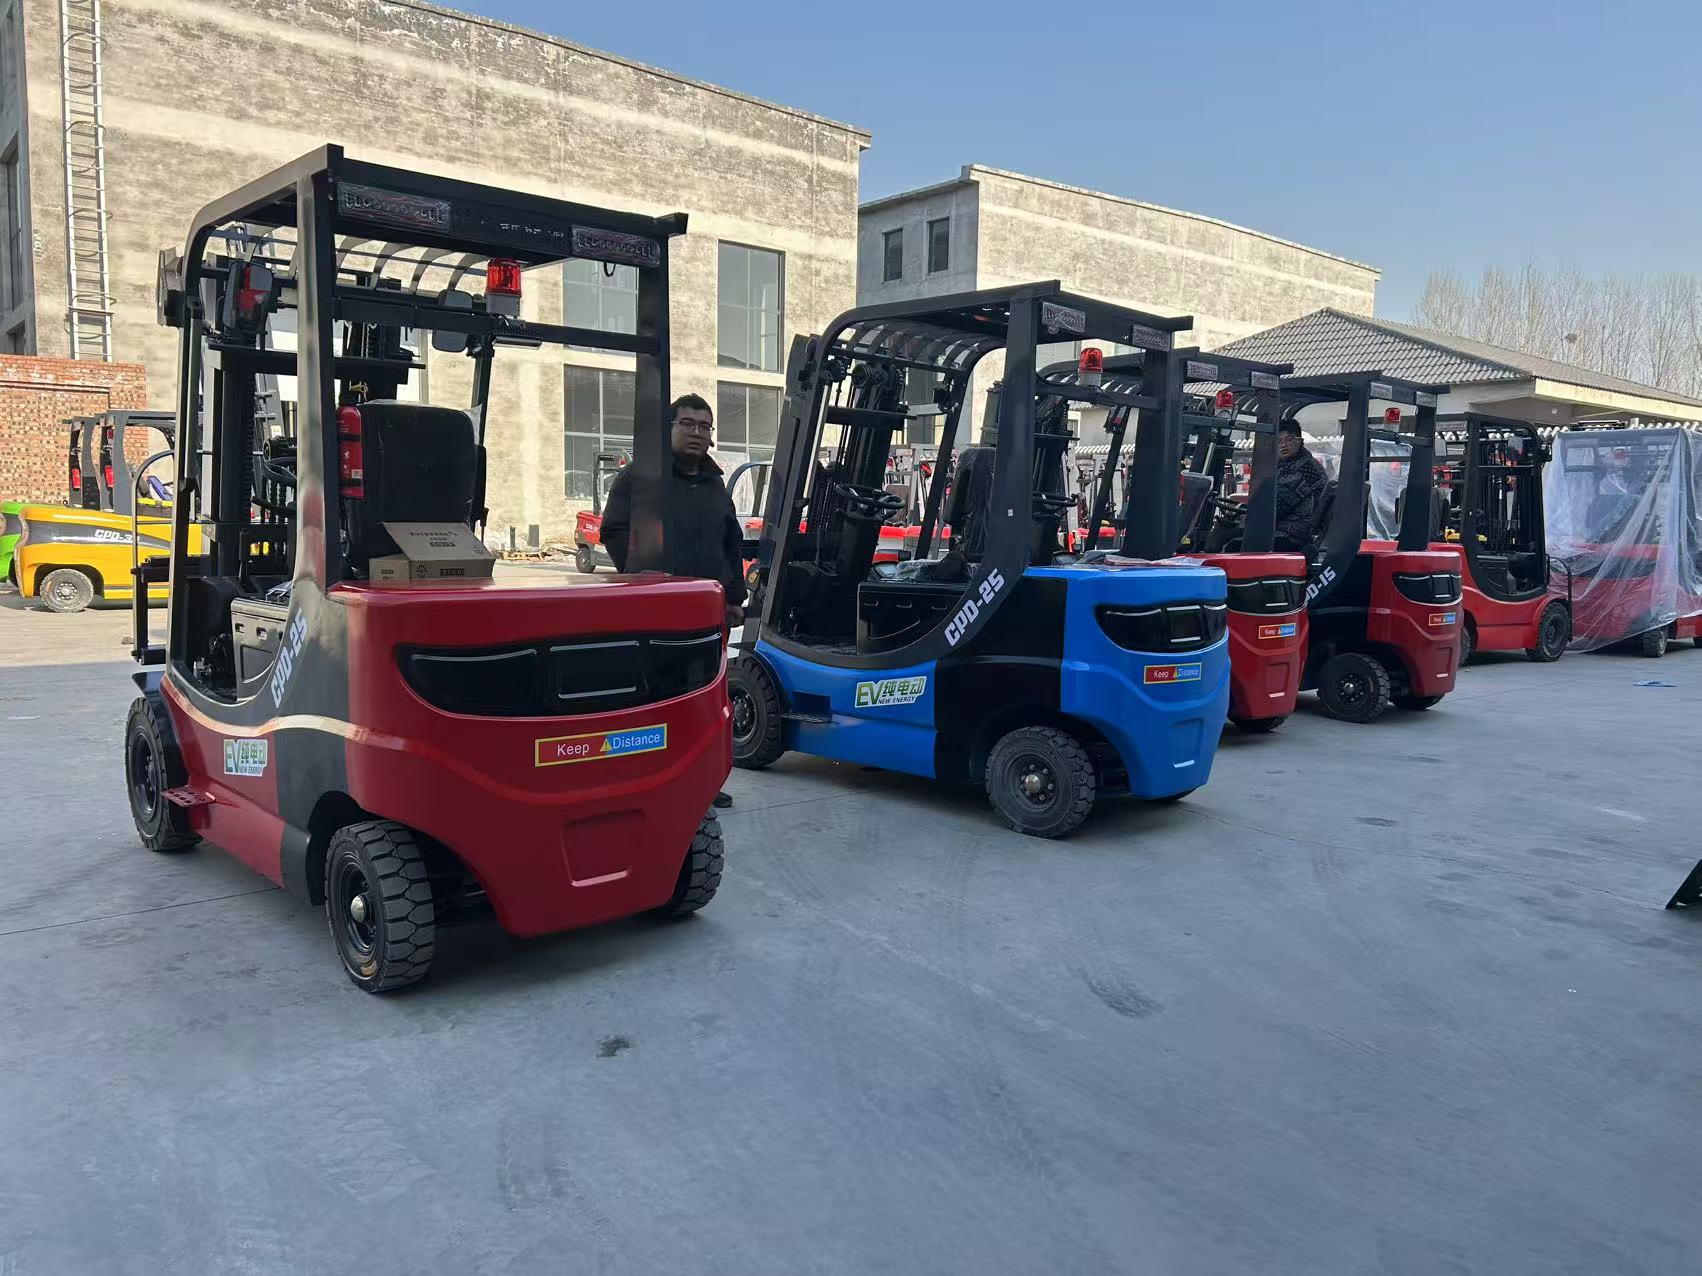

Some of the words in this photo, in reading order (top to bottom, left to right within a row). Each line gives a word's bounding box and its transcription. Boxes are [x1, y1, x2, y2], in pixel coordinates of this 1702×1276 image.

[944, 568, 1005, 646] CPD-25
[271, 607, 307, 708] CPD-25
[1153, 670, 1169, 679] Keep
[892, 696, 916, 704] ENERGY
[557, 743, 590, 756] Keep
[612, 733, 660, 749] Distance
